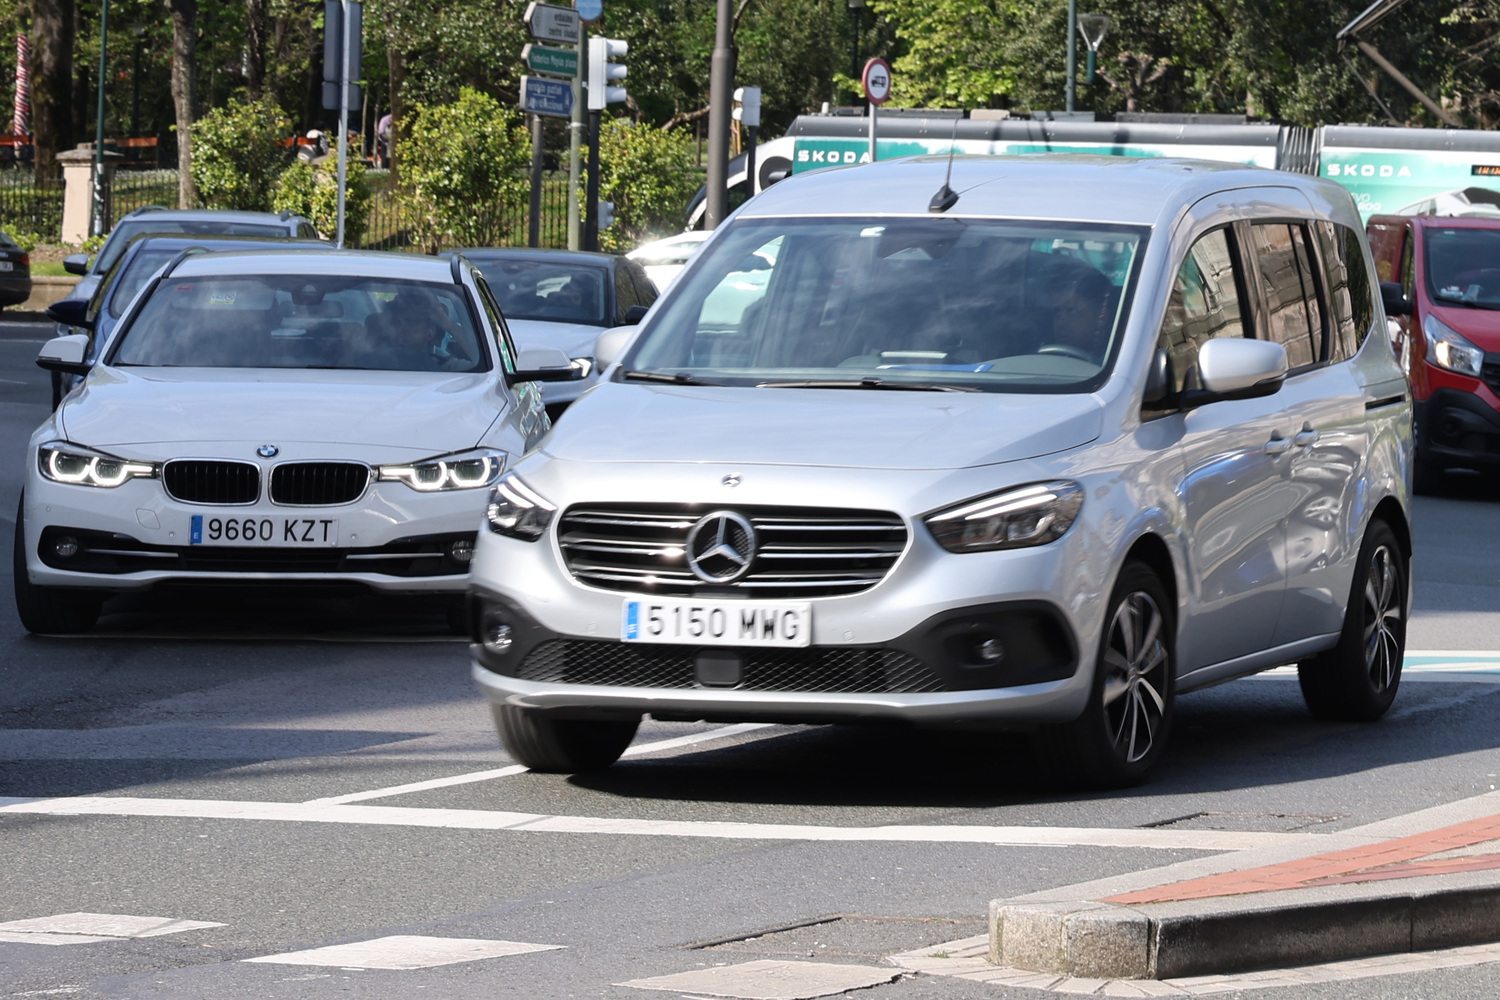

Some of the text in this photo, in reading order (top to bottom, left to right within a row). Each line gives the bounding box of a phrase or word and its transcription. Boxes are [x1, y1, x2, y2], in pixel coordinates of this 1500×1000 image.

[208, 518, 333, 542] 9660 KZT
[648, 605, 799, 640] 5150 MWG
